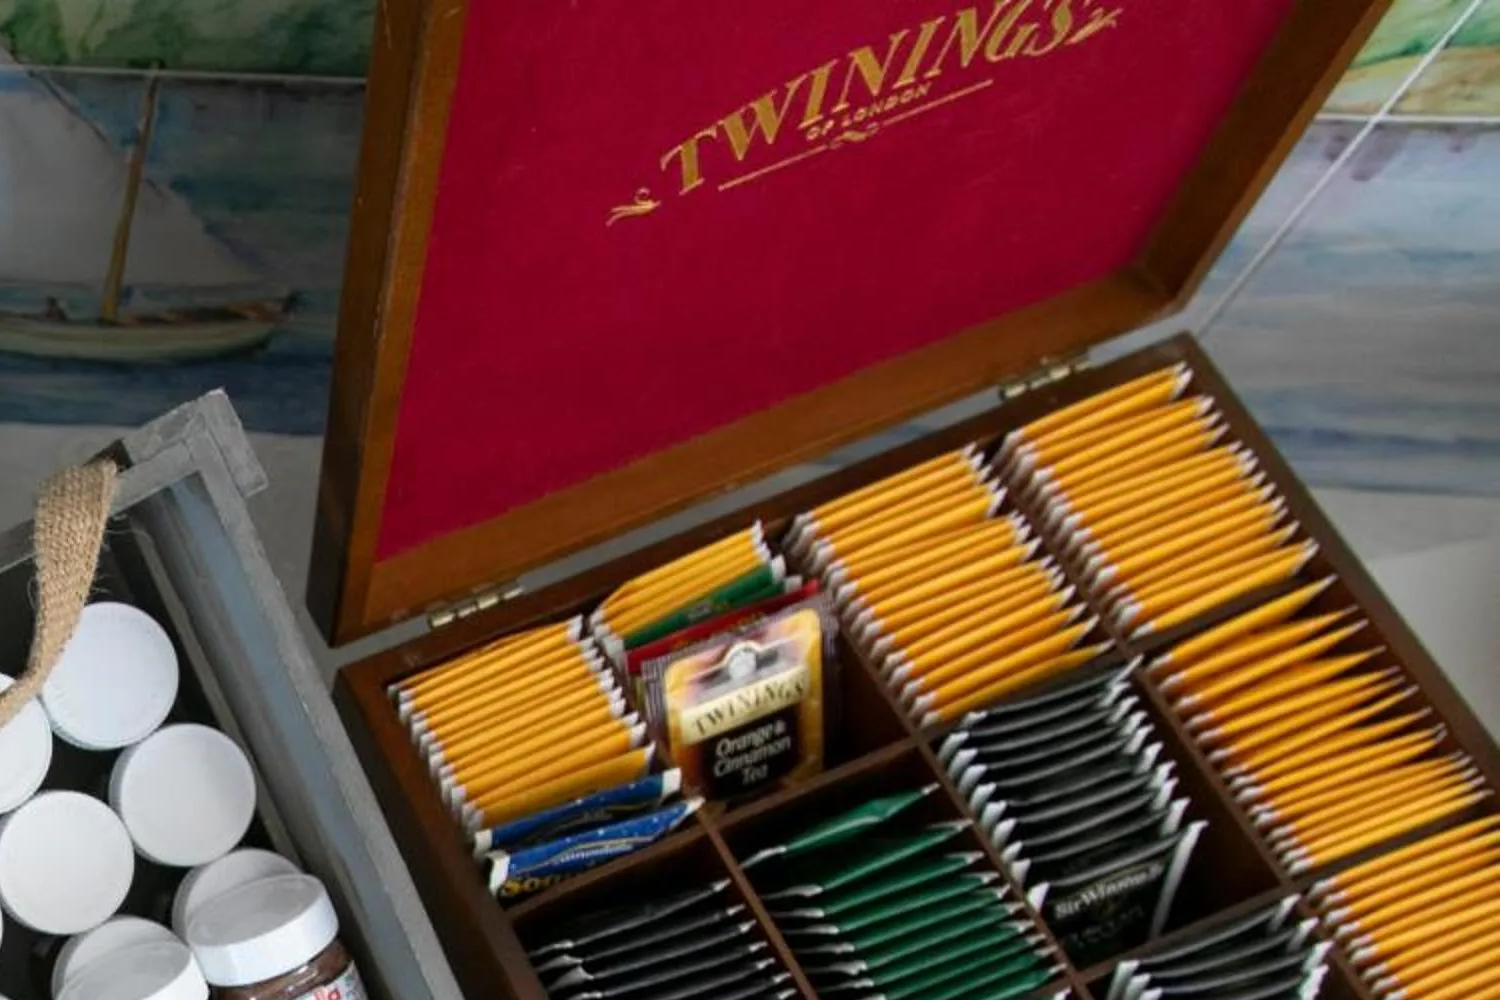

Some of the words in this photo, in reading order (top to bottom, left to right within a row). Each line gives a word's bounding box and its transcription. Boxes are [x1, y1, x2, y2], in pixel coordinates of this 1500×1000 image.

[660, 0, 1076, 195] TWININGS
[806, 119, 833, 141] OF
[841, 82, 933, 129] LONDON
